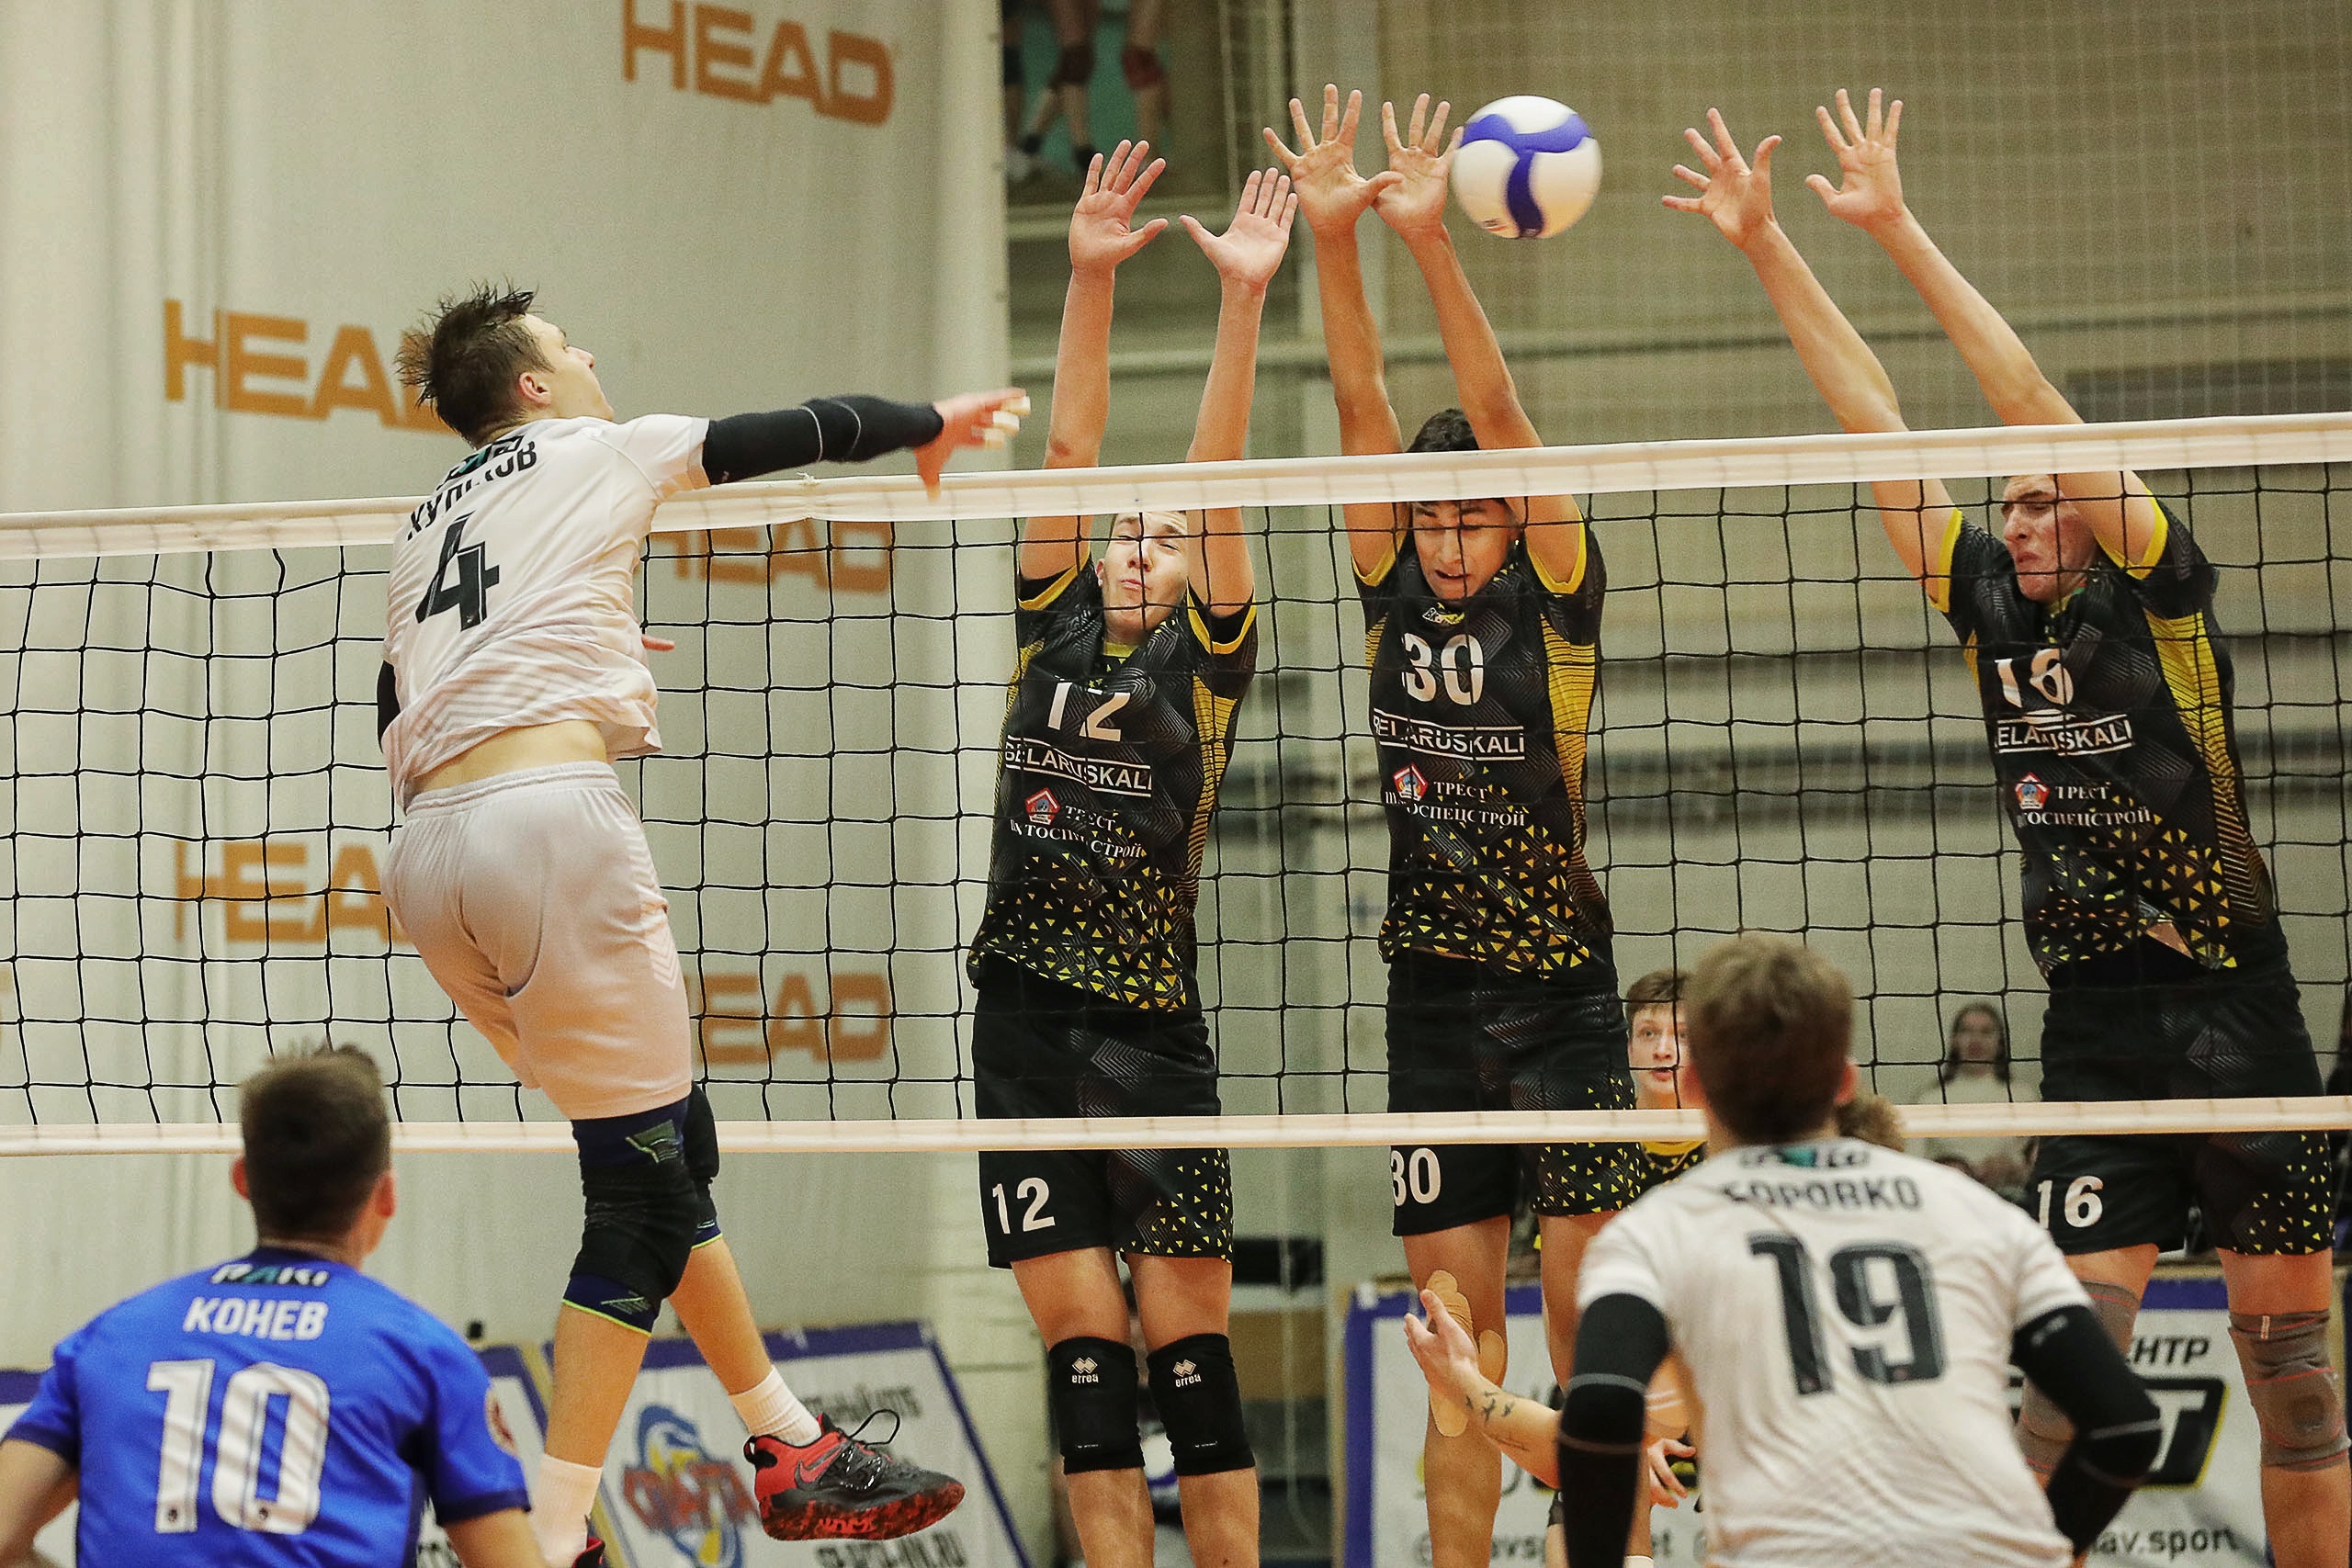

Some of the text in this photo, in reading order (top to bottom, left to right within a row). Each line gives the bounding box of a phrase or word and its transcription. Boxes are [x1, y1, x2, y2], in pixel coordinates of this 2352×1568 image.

[623, 0, 895, 127] HEAD
[164, 299, 461, 435] HEA
[415, 511, 500, 632] 4
[1401, 633, 1484, 705] 30
[2055, 786, 2109, 799] ТРЕСТ
[175, 841, 415, 946] HEA
[992, 1177, 1056, 1234] 12
[1390, 1147, 1441, 1206] 30
[2037, 1176, 2104, 1229] 16
[183, 1296, 328, 1340] КОНЕВ
[1747, 1231, 1947, 1394] 19
[146, 1359, 331, 1535] 10
